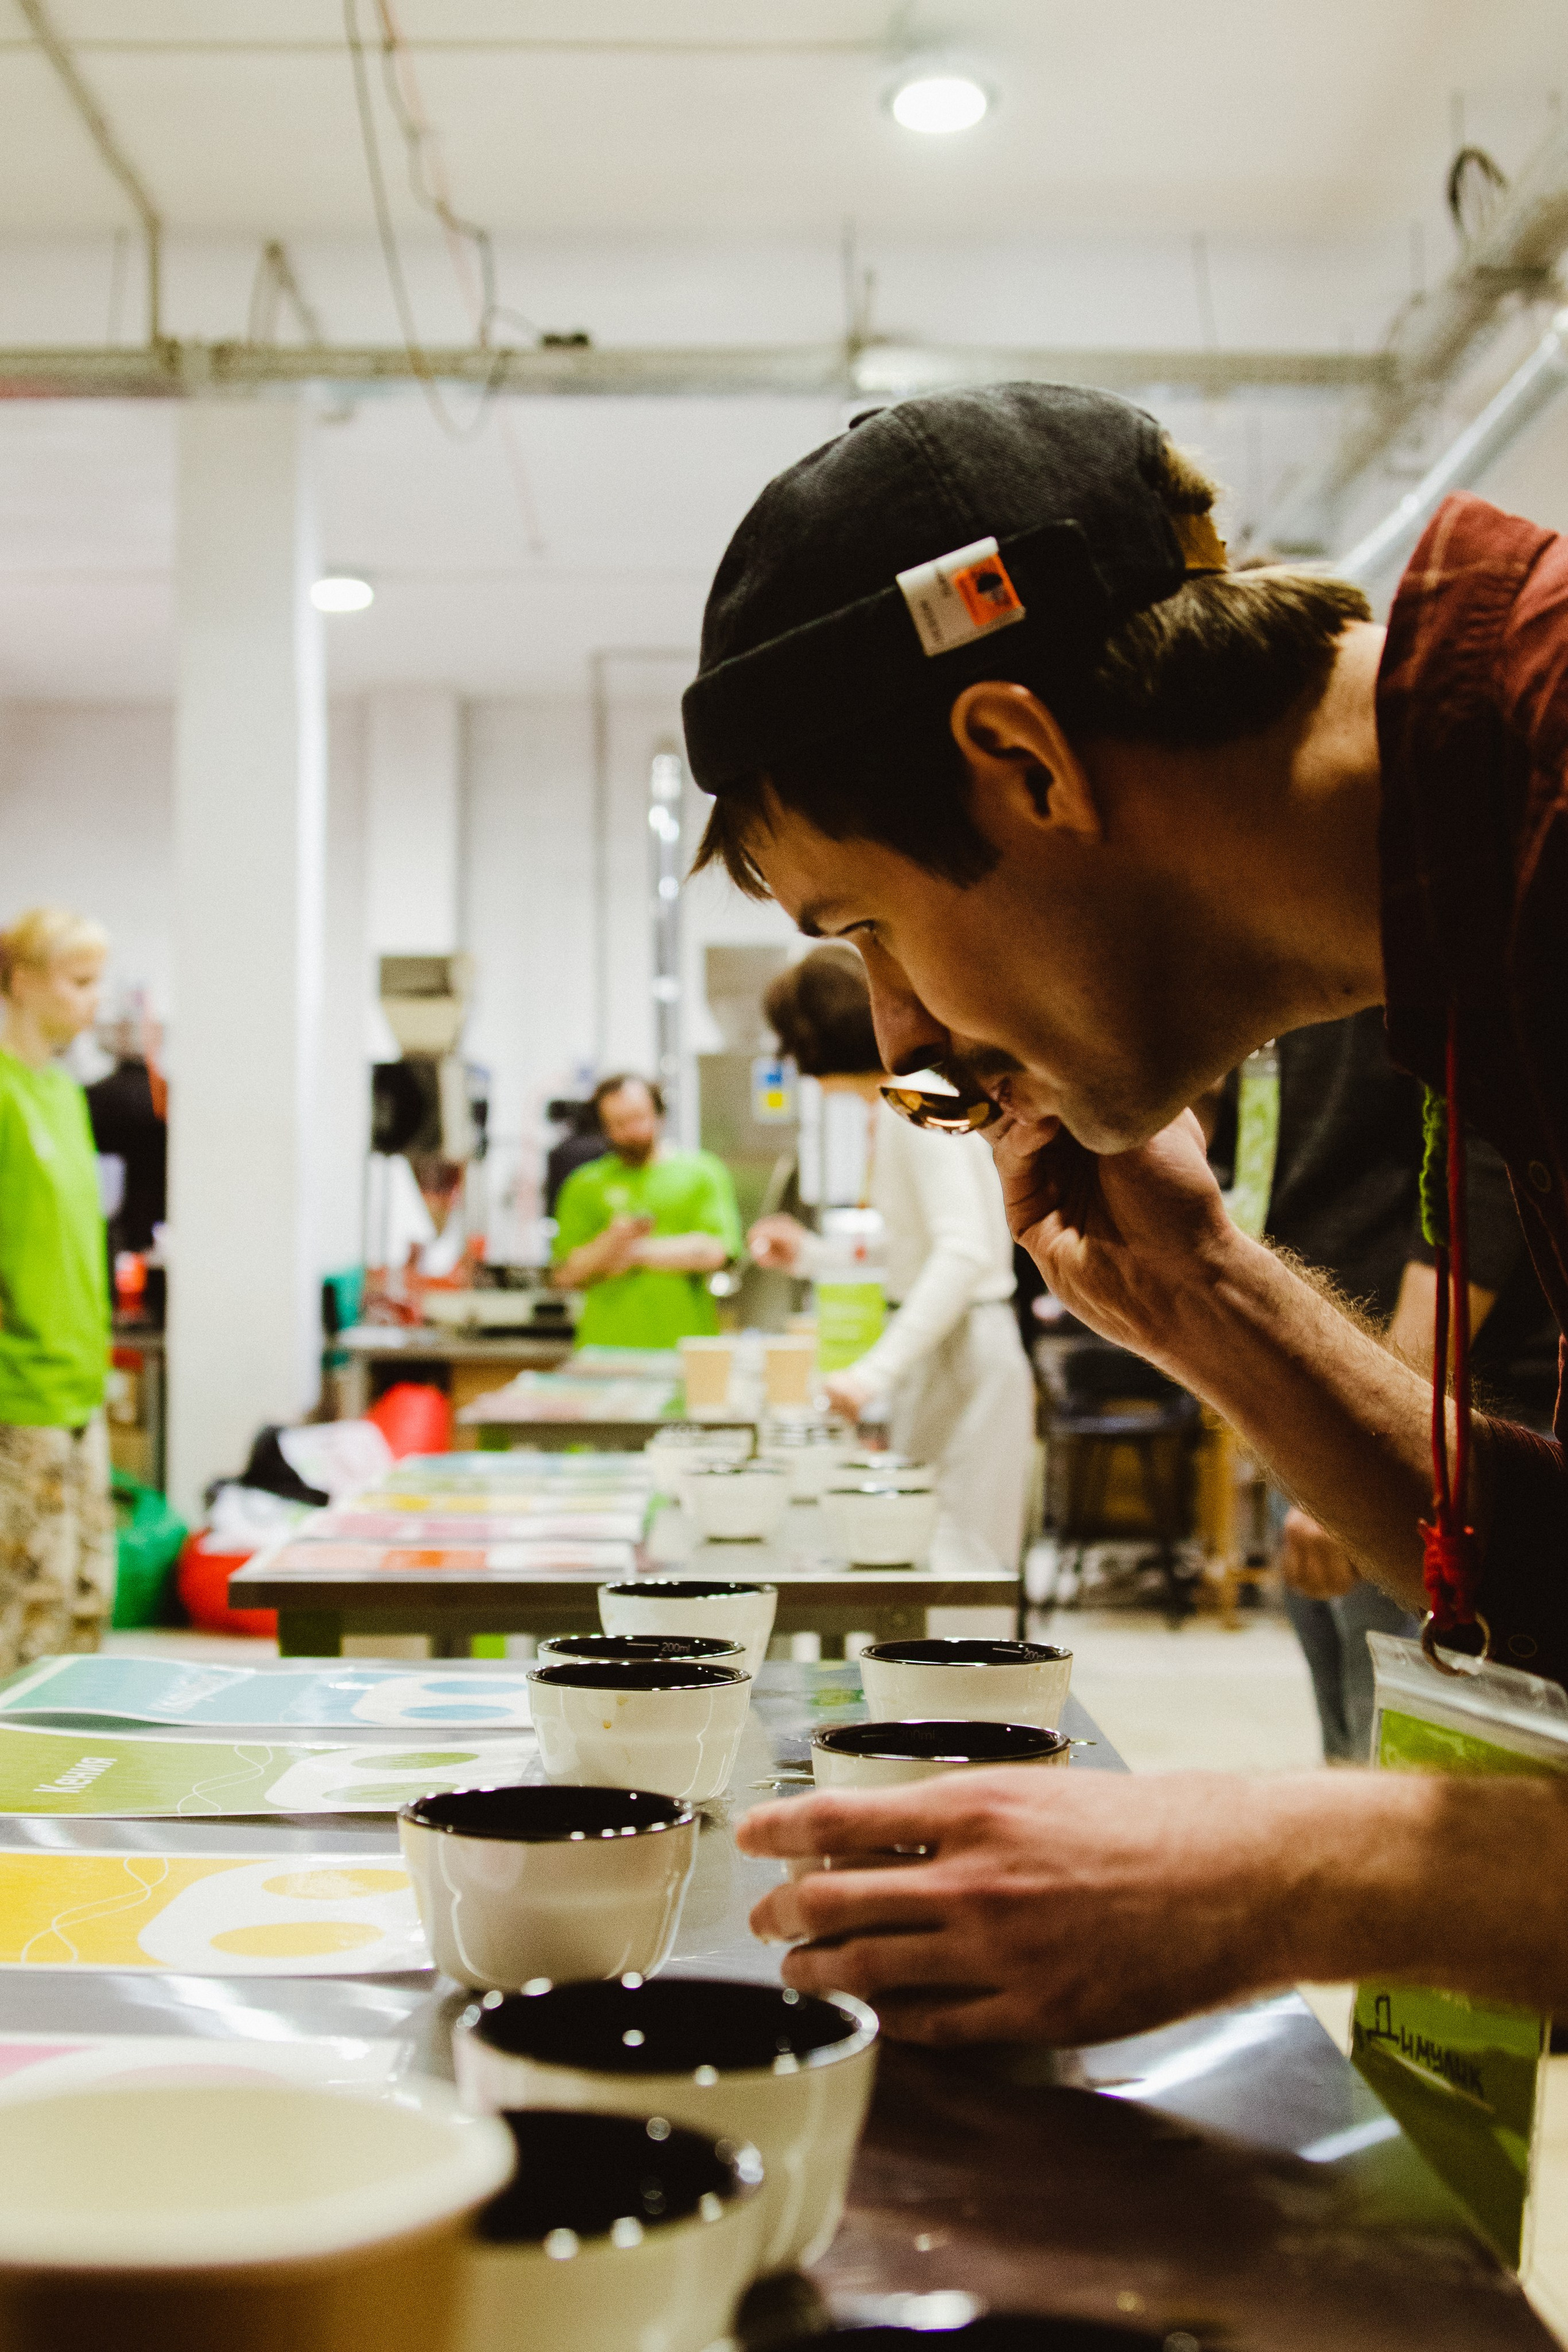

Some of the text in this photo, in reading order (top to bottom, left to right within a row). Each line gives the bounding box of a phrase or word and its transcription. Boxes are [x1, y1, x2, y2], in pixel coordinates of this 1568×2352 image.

[662, 1642, 690, 1653] 200ml
[900, 1729, 935, 1740] 200ml
[34, 1757, 118, 1793] Кения
